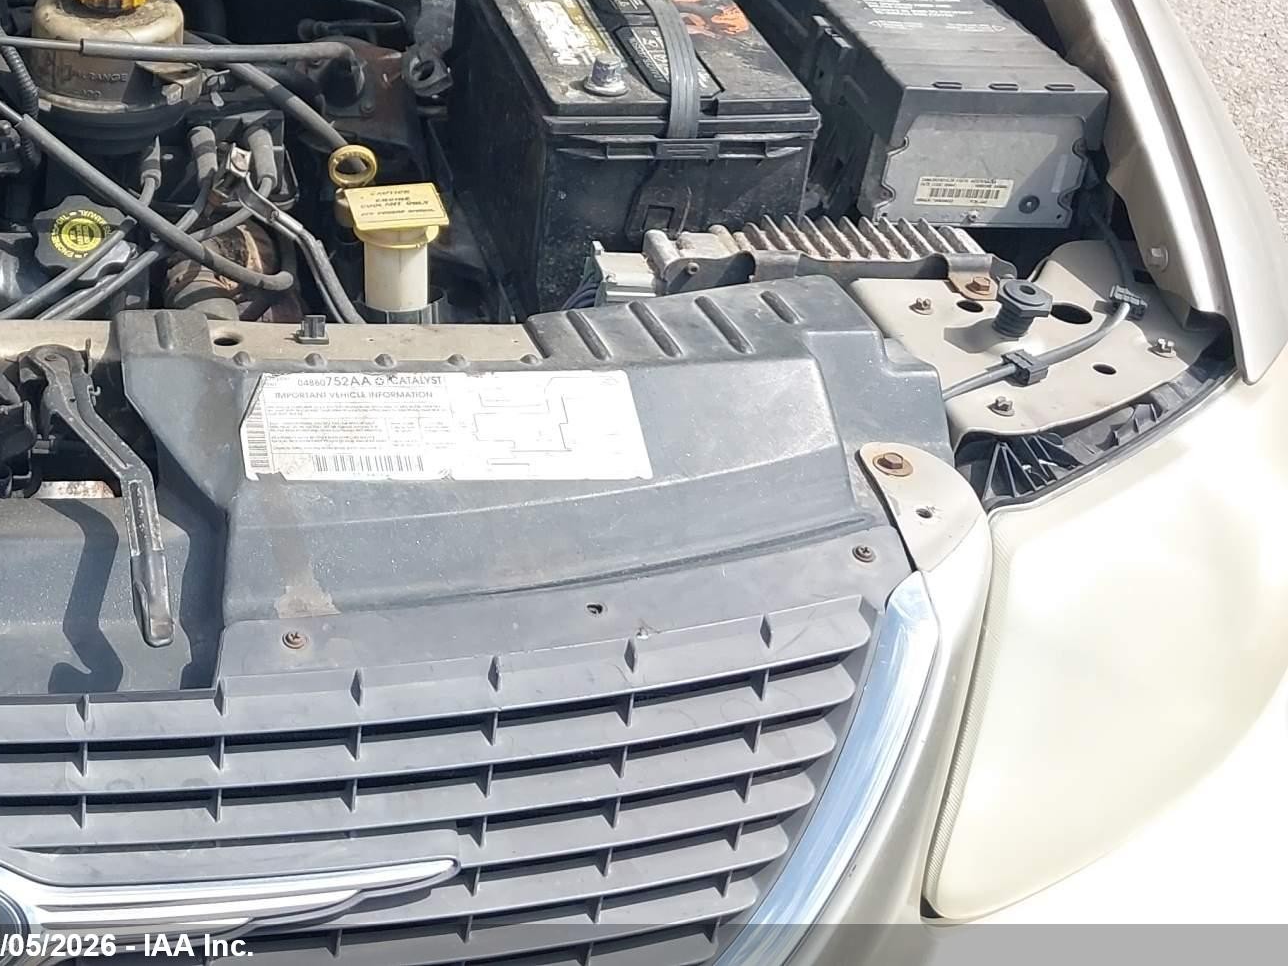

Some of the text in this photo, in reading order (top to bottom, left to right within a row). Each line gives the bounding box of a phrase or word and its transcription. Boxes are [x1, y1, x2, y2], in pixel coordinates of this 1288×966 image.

[55, 214, 71, 226] OIL
[297, 376, 372, 387] 04860752AA
[390, 376, 442, 385] CATALYST
[275, 391, 433, 399] IMPORTANT VEHICLE INFORMATION
